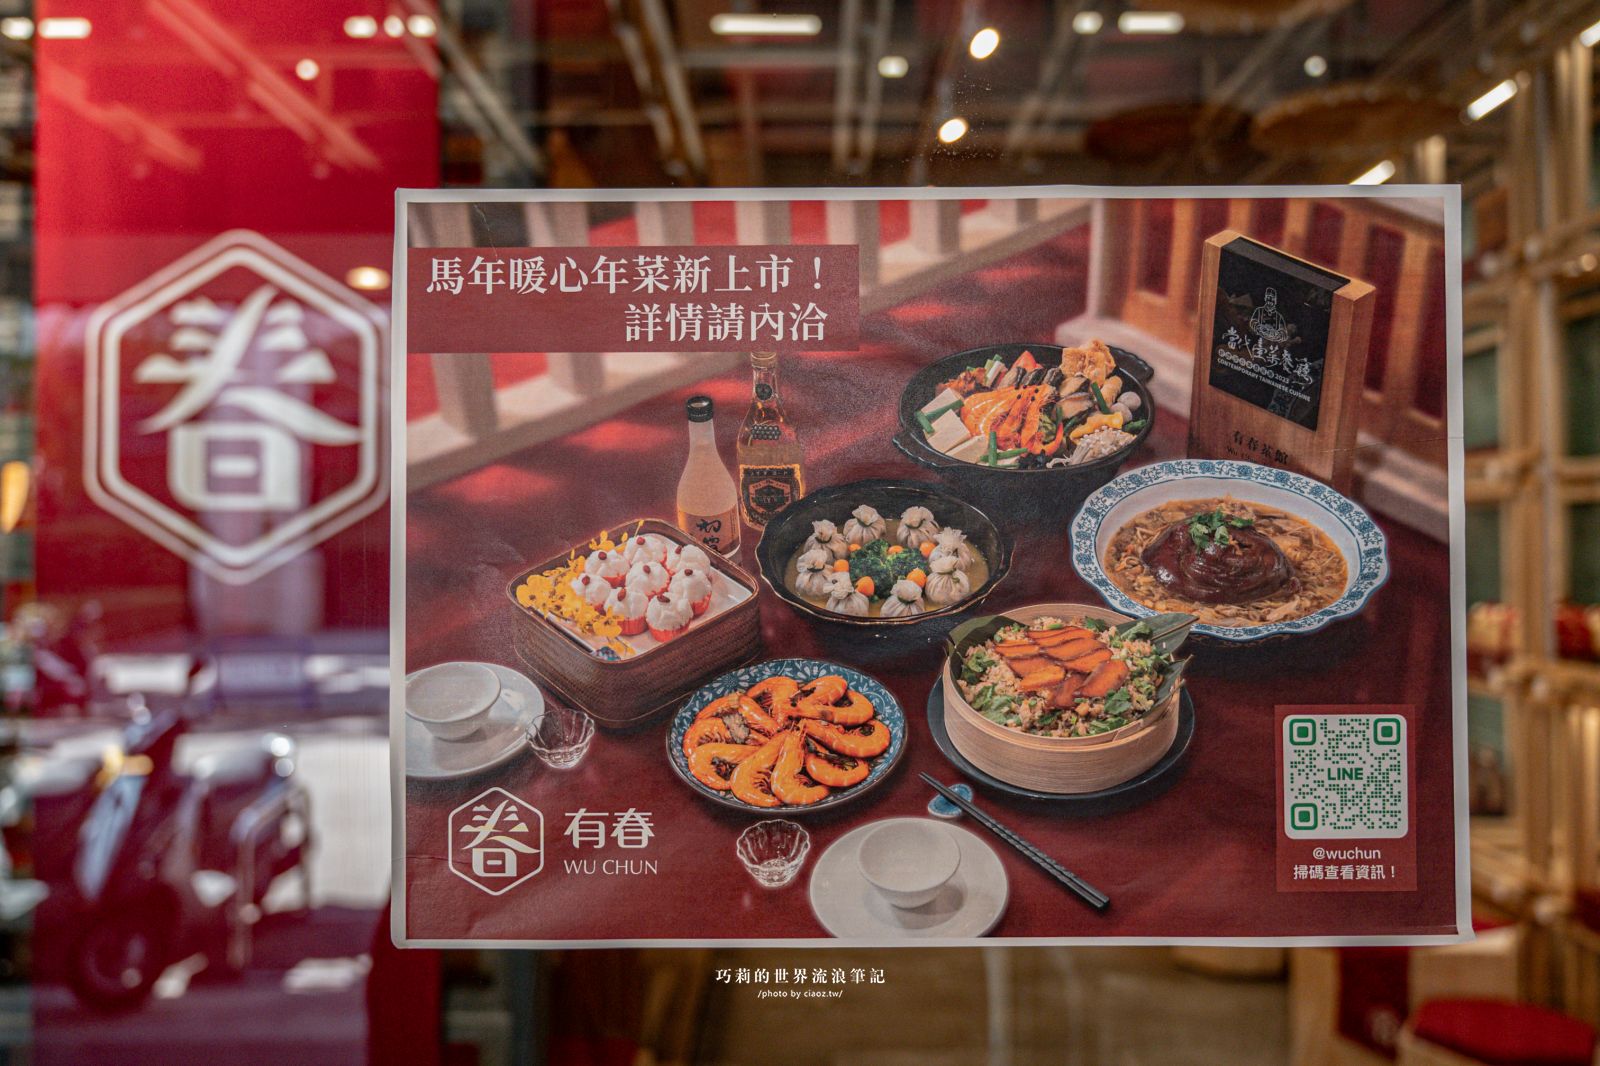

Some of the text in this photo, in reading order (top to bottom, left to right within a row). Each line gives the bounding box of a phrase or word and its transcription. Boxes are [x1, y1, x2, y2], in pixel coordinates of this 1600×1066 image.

[426, 254, 823, 295] 馬年暖心年菜新上市！
[624, 302, 829, 342] 詳情請內洽
[133, 283, 365, 512] 春
[1217, 358, 1259, 380] CONTEMPORARY
[1288, 388, 1311, 402] CUISINE
[1327, 767, 1364, 781] LINE
[459, 799, 542, 877] 春
[563, 807, 656, 849] 有春
[563, 860, 658, 875] WU CHUN
[1293, 864, 1396, 880] 掃碼查看資訊！
[1312, 847, 1382, 861] @wuchun
